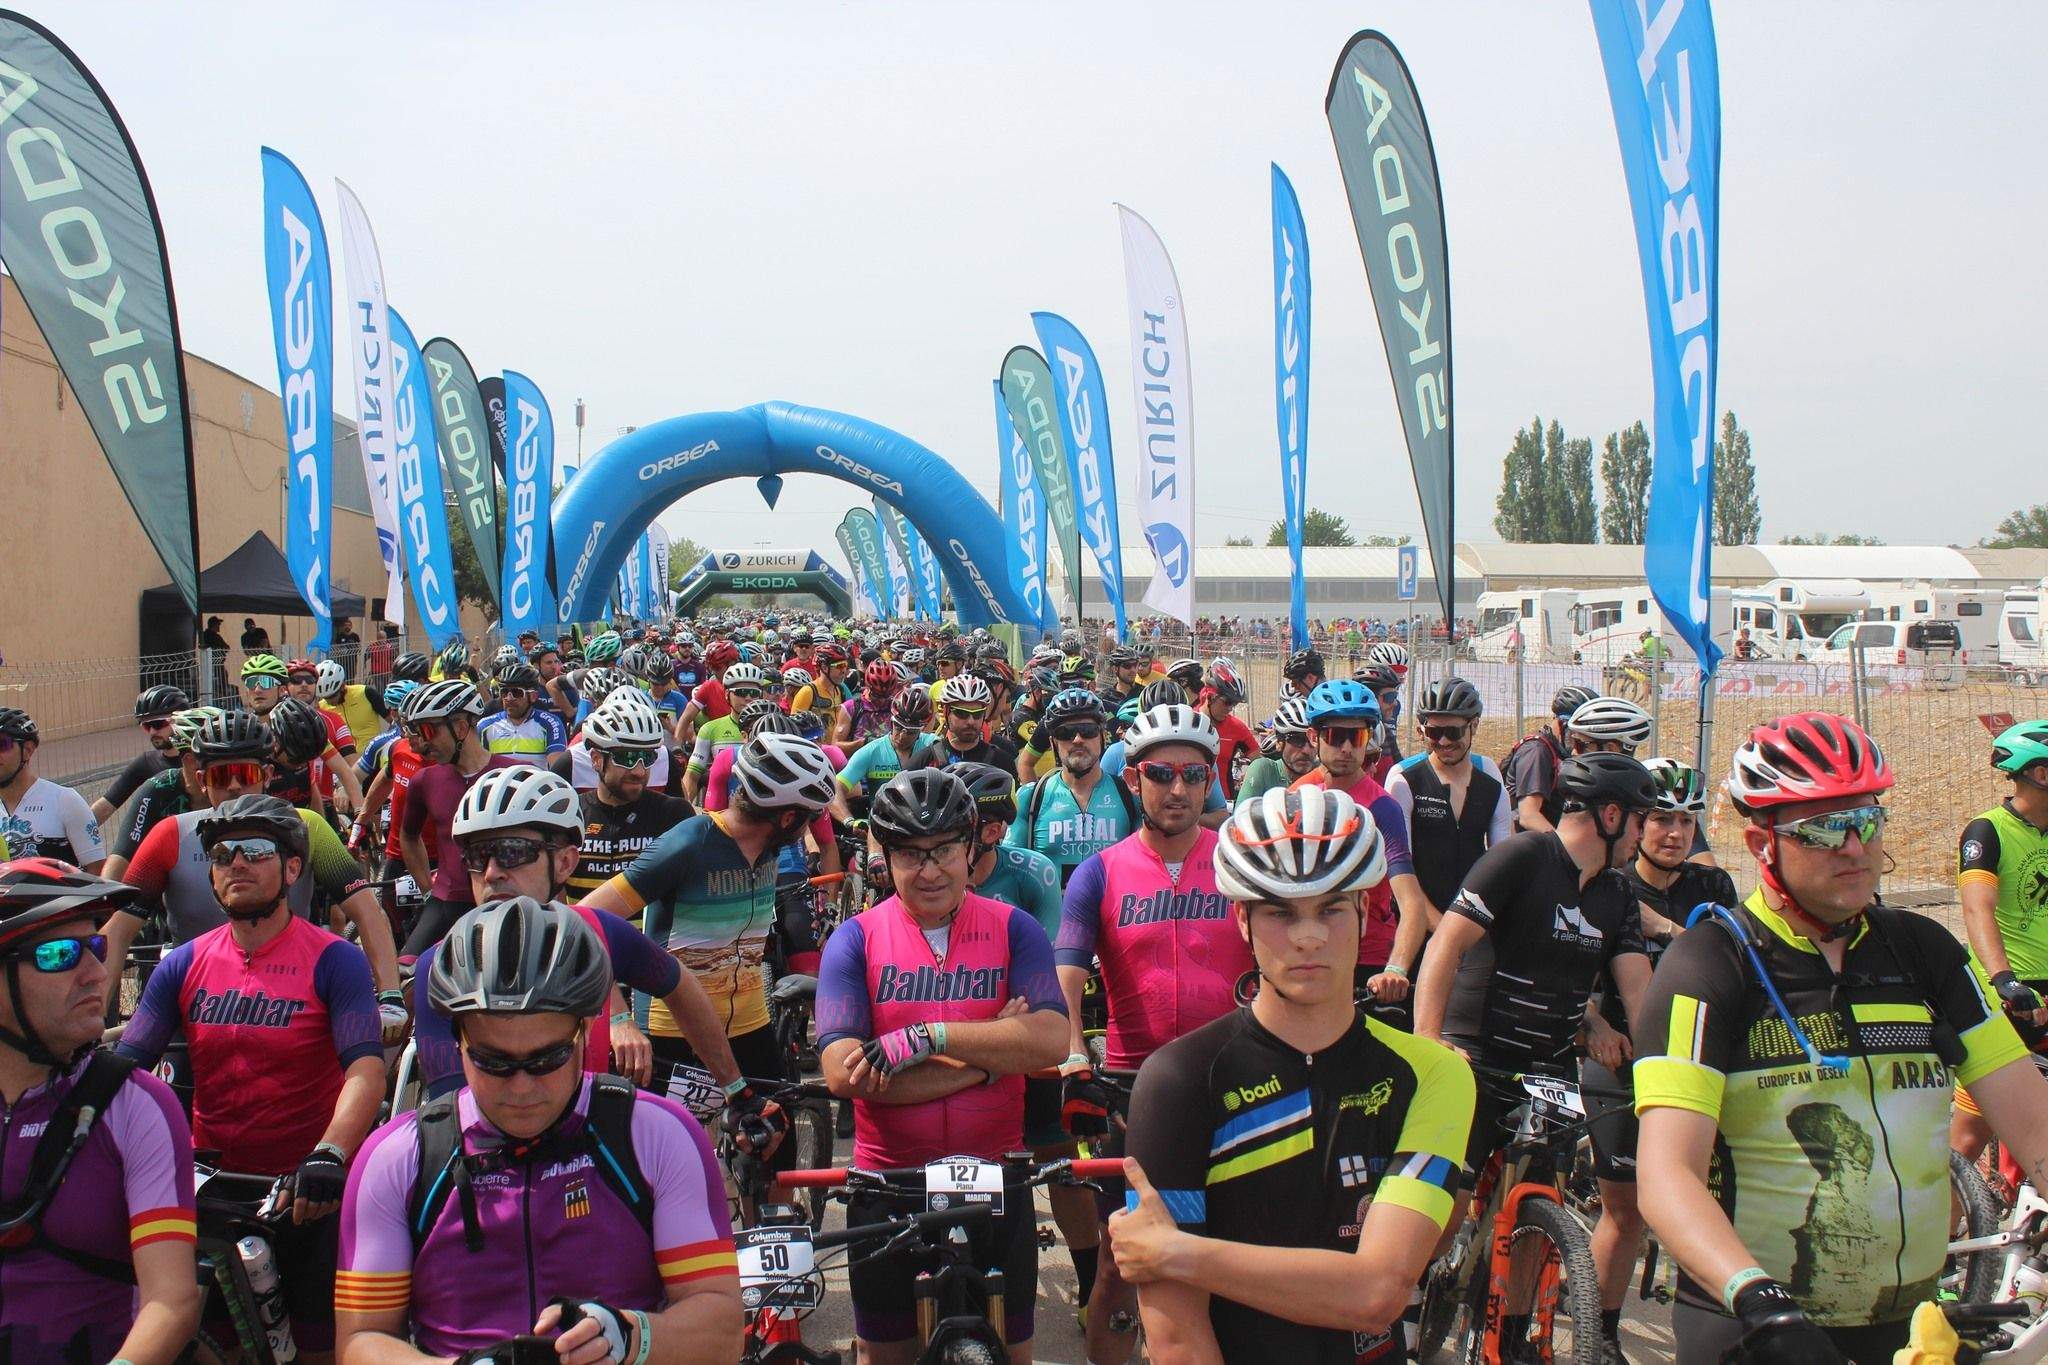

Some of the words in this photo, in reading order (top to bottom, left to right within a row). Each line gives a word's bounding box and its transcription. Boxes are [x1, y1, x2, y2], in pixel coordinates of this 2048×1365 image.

[638, 439, 720, 482] ORBEA
[815, 445, 904, 497] ORBEA
[559, 520, 606, 623] ORBEA
[747, 555, 796, 566] ZURICH
[1402, 553, 1412, 592] P
[732, 577, 798, 589] SKODA
[978, 795, 1007, 803] SCOTT
[578, 836, 654, 853] IKE-RUN
[1561, 932, 1603, 949] elements
[875, 963, 1010, 1004] Ballobar
[188, 988, 305, 1029] Ballobar
[1239, 1074, 1282, 1103] barri
[1757, 1071, 1812, 1089] EUROPEAN
[1817, 1067, 1849, 1081] DESERT
[948, 1165, 980, 1182] 127
[747, 1230, 793, 1243] Columbus
[759, 1244, 790, 1271] 50
